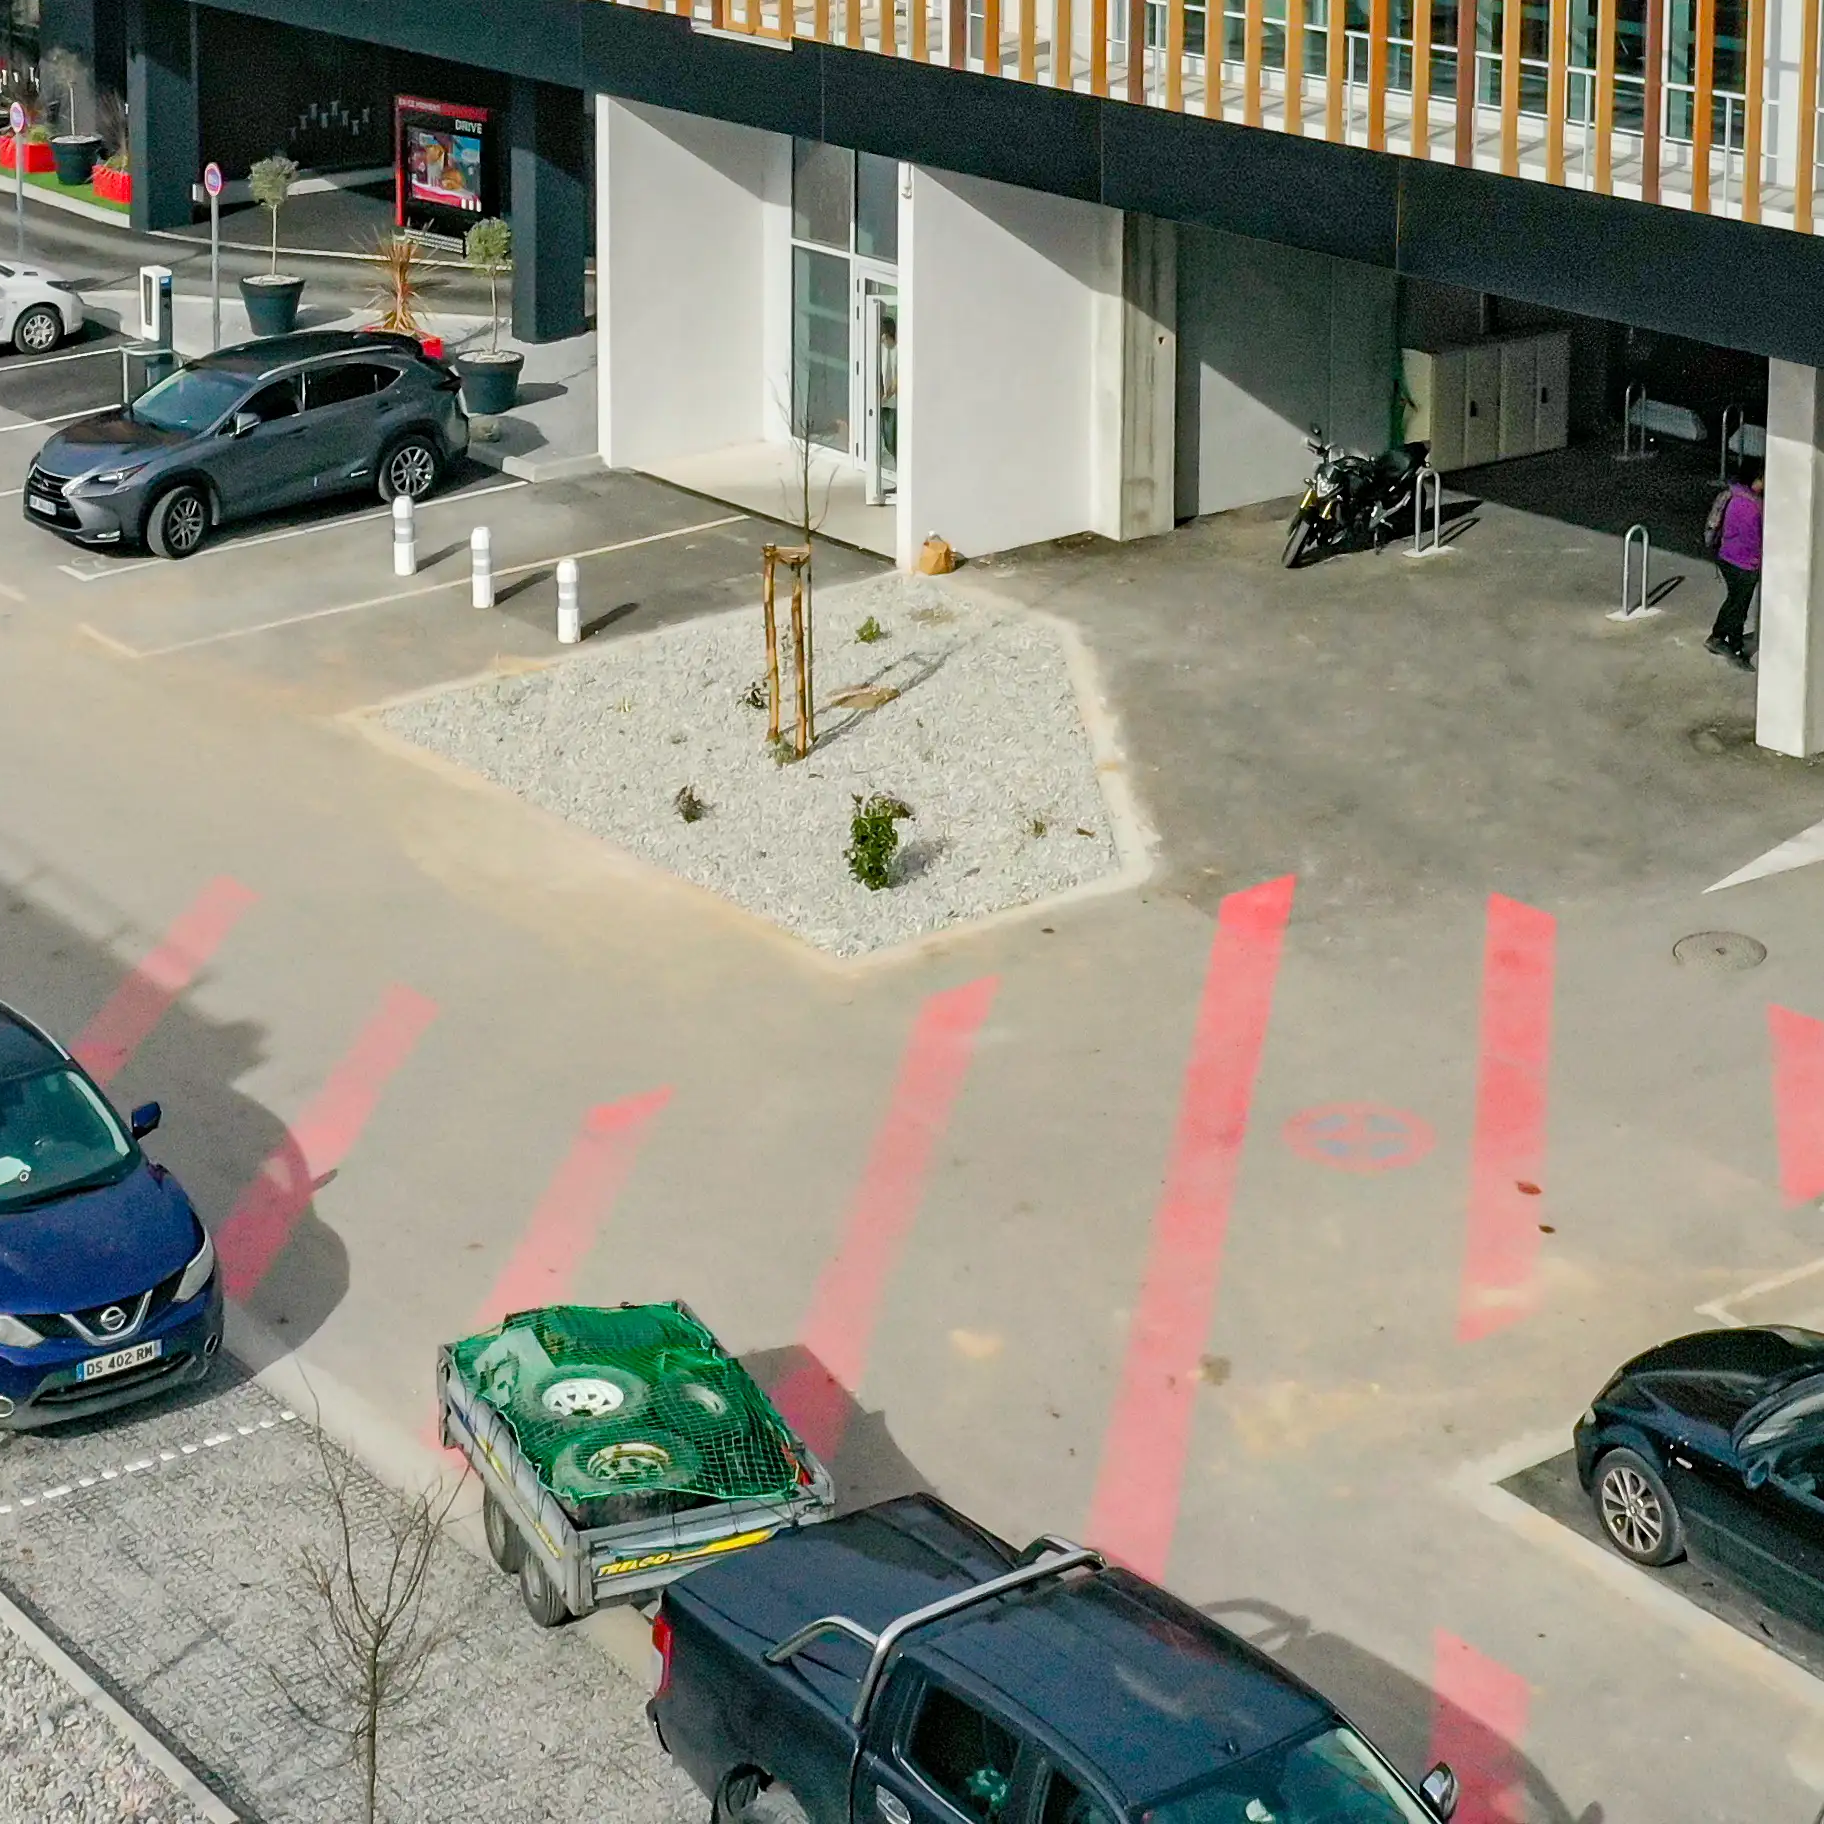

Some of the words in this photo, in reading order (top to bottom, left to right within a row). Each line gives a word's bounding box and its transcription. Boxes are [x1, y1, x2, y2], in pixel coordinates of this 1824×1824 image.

[455, 119, 483, 135] DRIVE
[87, 1360, 103, 1376] DS
[108, 1352, 133, 1369] 402
